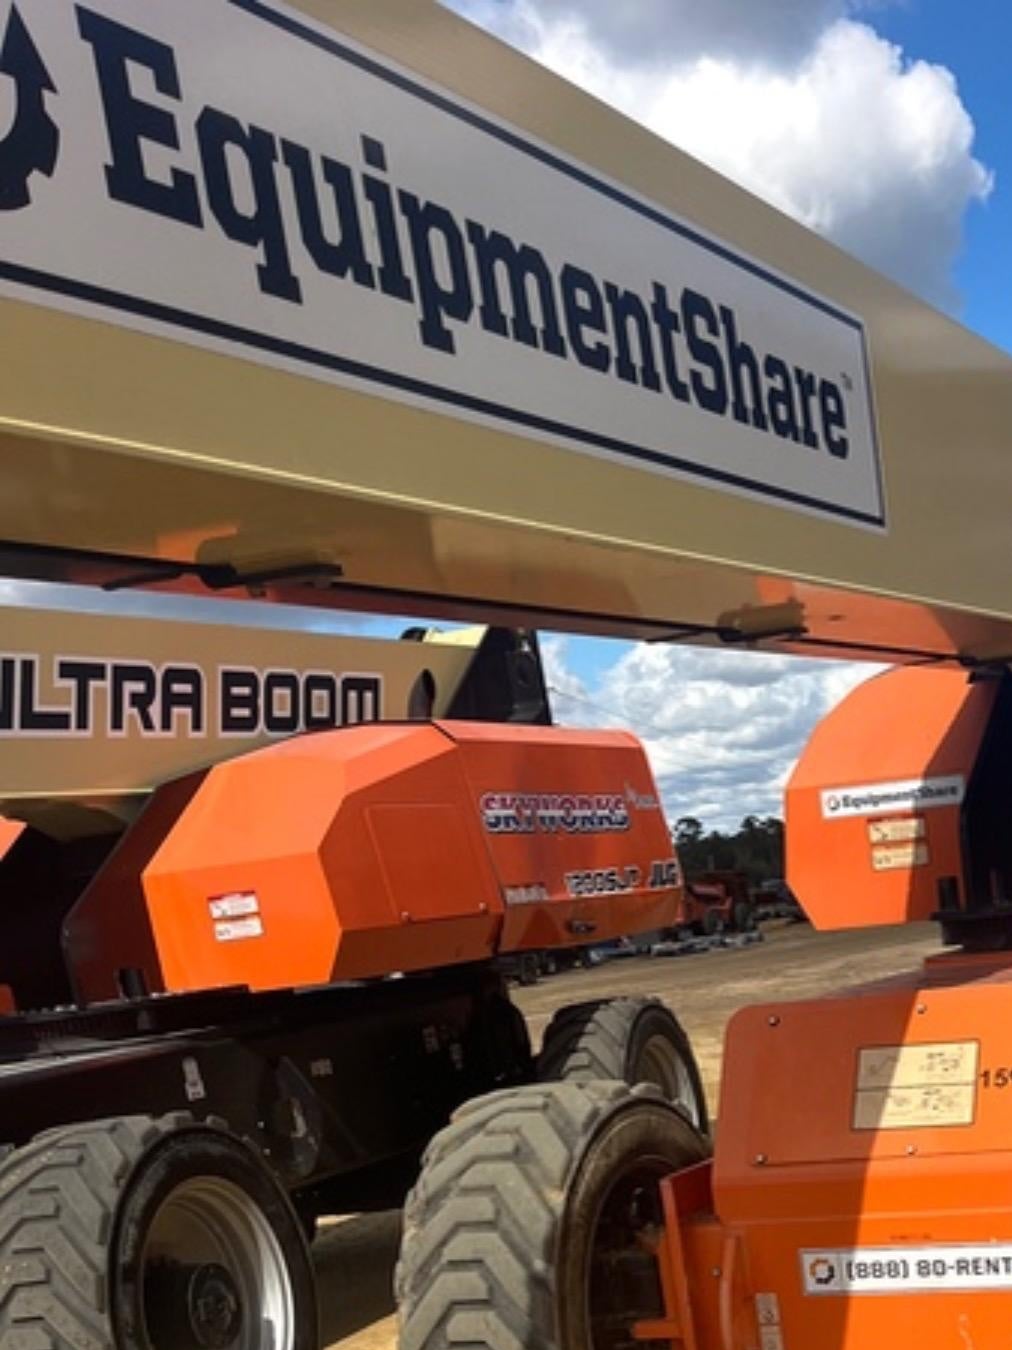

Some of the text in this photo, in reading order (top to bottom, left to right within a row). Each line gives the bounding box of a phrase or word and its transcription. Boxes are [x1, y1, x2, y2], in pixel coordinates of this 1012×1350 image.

[74, 3, 850, 460] EquipmentShare
[0, 657, 382, 735] LTRA BOOM
[481, 793, 630, 832] SKYWORKS
[841, 784, 959, 810] EquipmentShare
[846, 1259, 910, 1280] (888)
